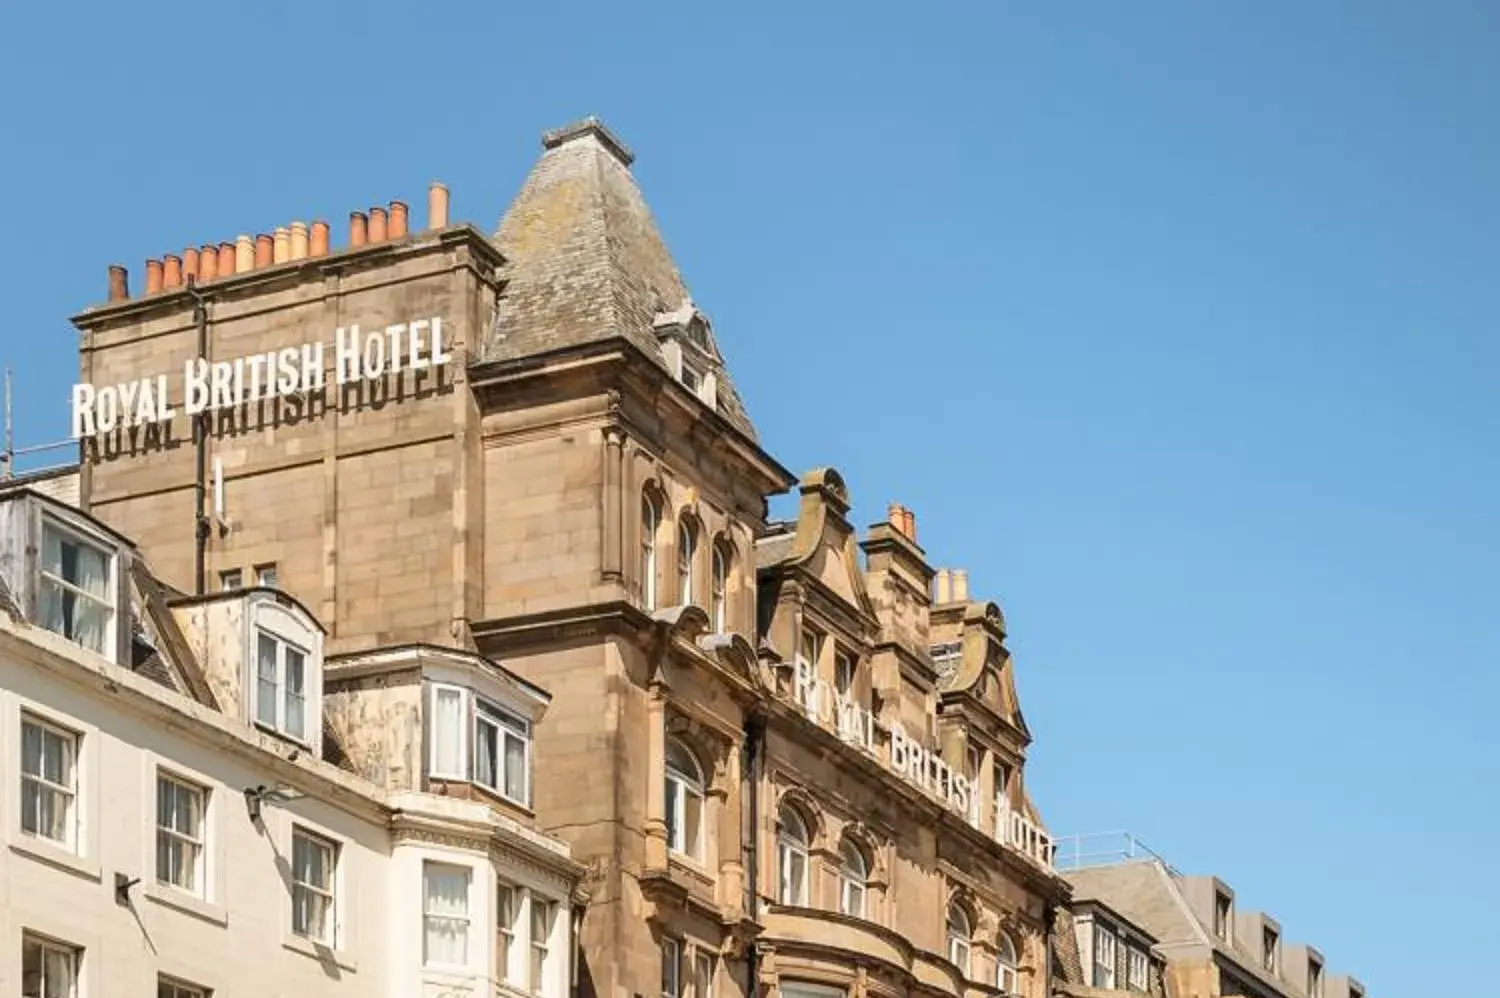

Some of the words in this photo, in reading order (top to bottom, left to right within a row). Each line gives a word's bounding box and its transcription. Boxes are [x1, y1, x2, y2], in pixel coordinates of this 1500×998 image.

[71, 374, 176, 439] ROYAL
[184, 340, 325, 415] BRITISH
[335, 316, 452, 385] HOTEL
[892, 722, 980, 830] BRITISH
